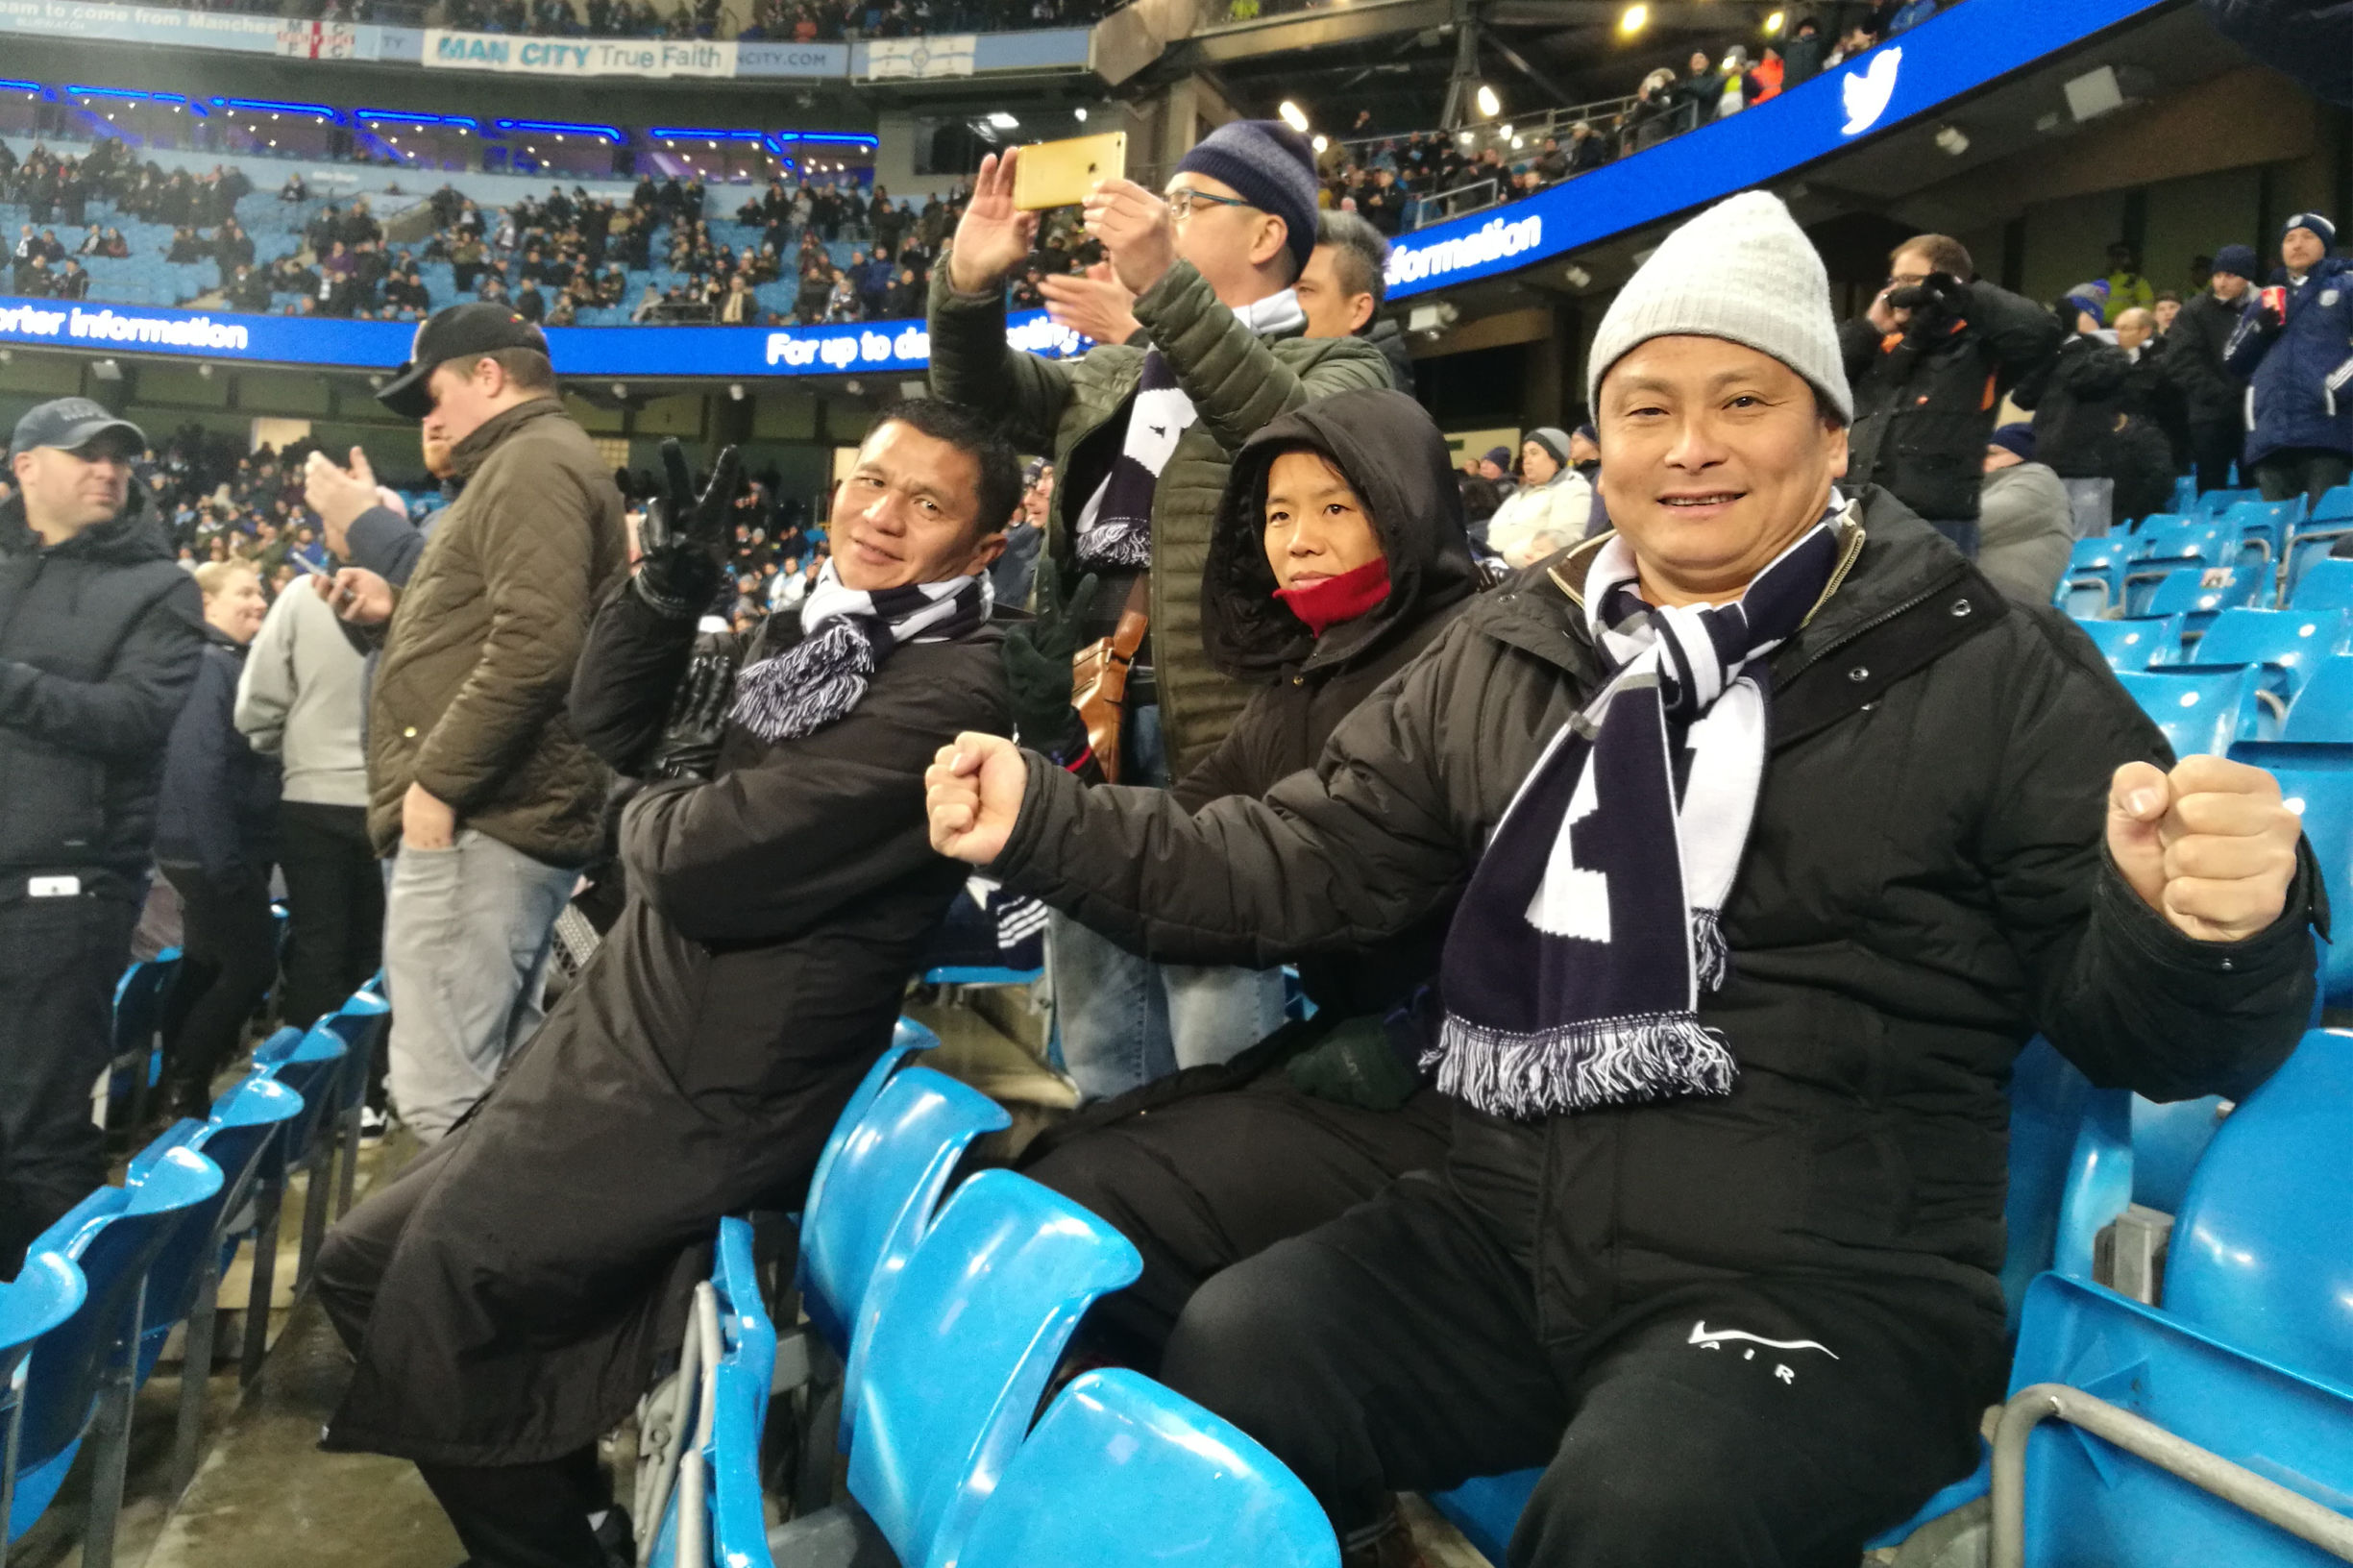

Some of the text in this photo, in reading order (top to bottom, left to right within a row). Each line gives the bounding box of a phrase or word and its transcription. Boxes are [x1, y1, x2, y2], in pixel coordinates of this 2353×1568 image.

[45, 2, 66, 17] to
[73, 7, 129, 21] come
[135, 9, 182, 26] from
[438, 37, 721, 69] MAN CITY True Faith
[69, 307, 249, 350] information
[767, 332, 821, 365] For
[820, 336, 858, 369] up
[861, 331, 892, 361] to
